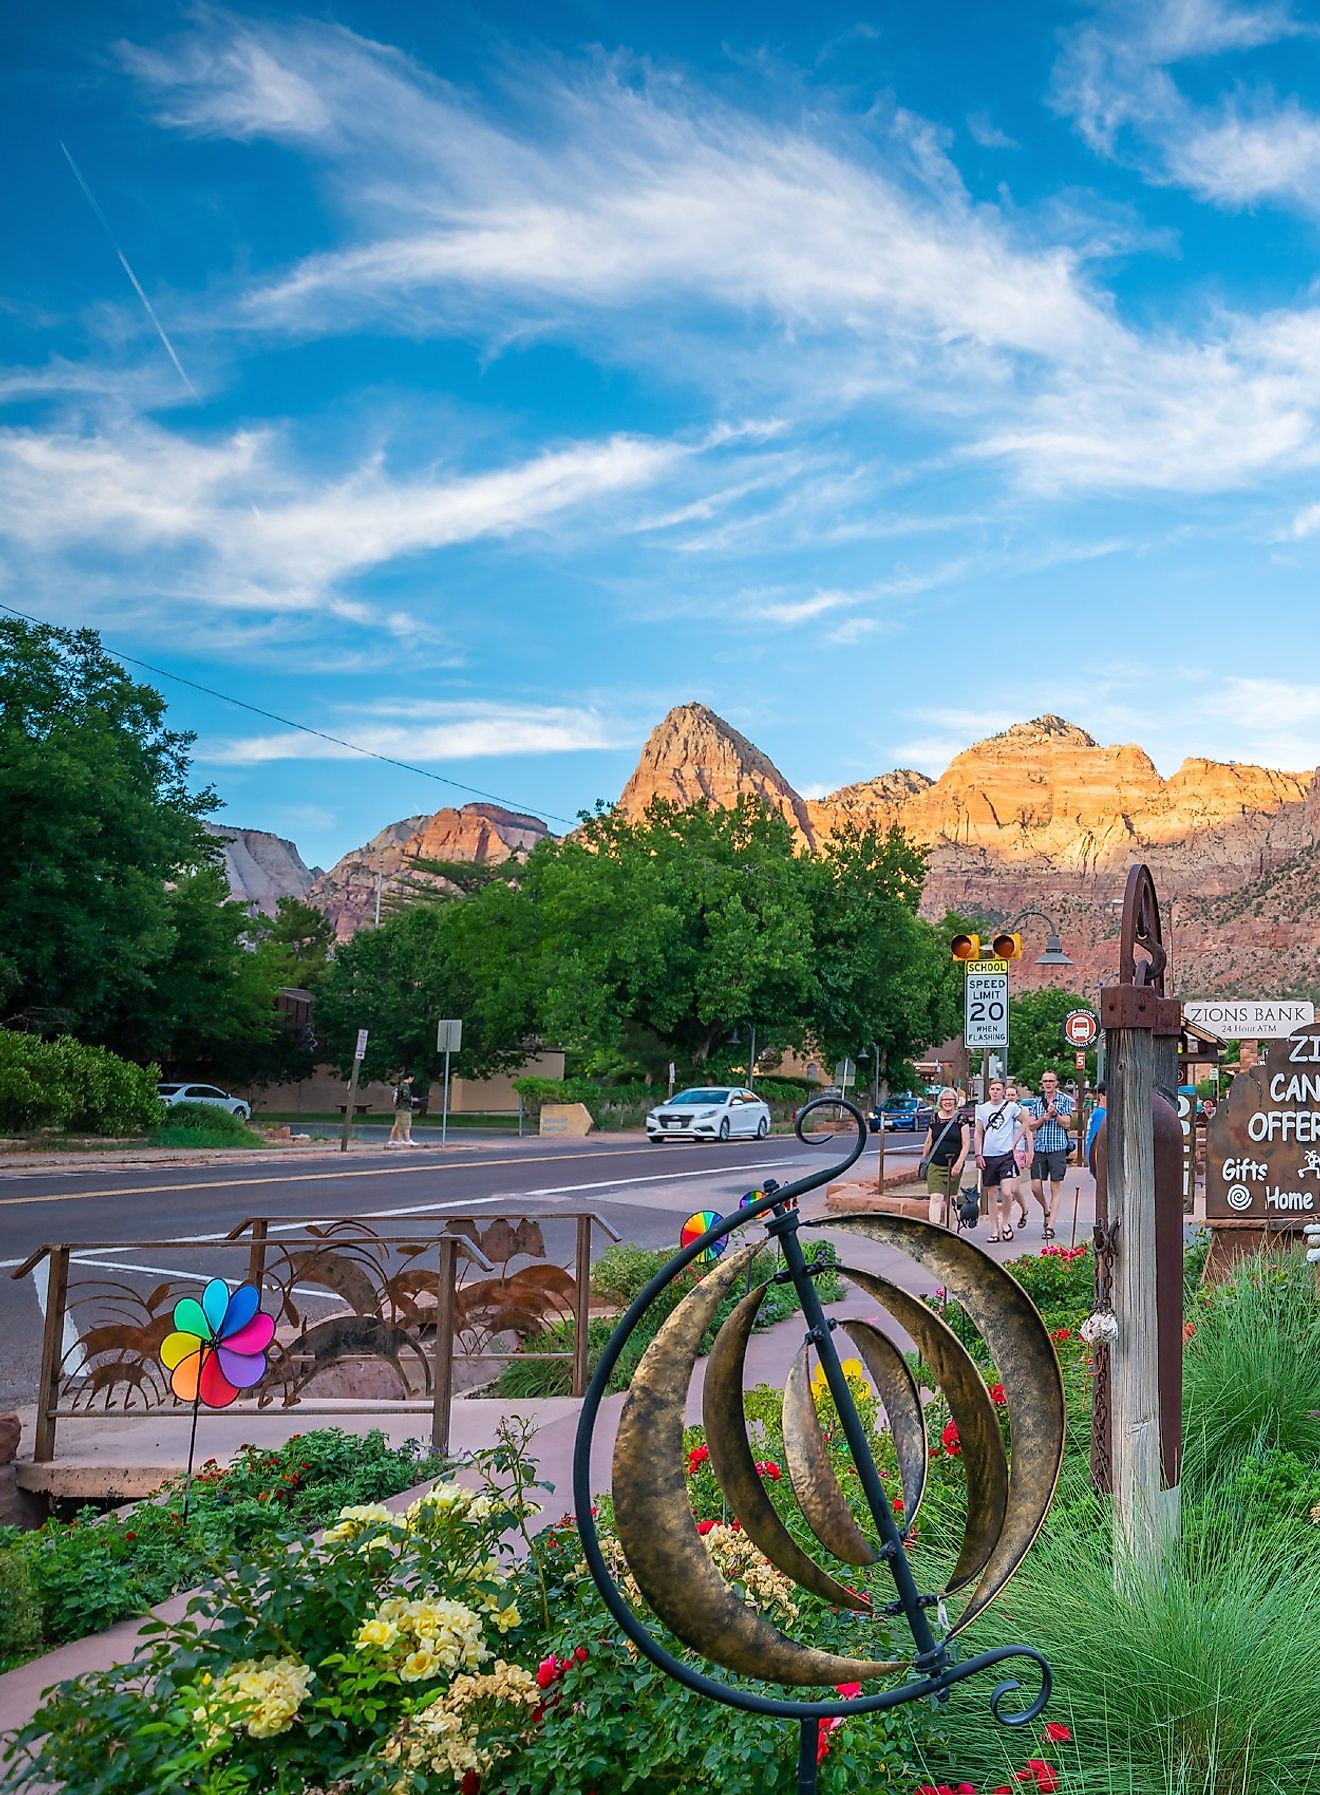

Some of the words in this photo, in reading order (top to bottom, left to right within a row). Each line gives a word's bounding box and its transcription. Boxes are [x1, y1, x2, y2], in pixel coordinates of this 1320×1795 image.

[969, 963, 1006, 972] SCHOOL
[969, 980, 1005, 989] SPEED
[973, 991, 1000, 1000] LIMIT
[970, 1002, 1004, 1021] 20
[1191, 1008, 1248, 1022] ZIONS
[1255, 1007, 1306, 1021] BANK
[1078, 1056, 1084, 1066] 5
[1222, 1158, 1268, 1181] Gifts
[1265, 1185, 1314, 1210] Home
